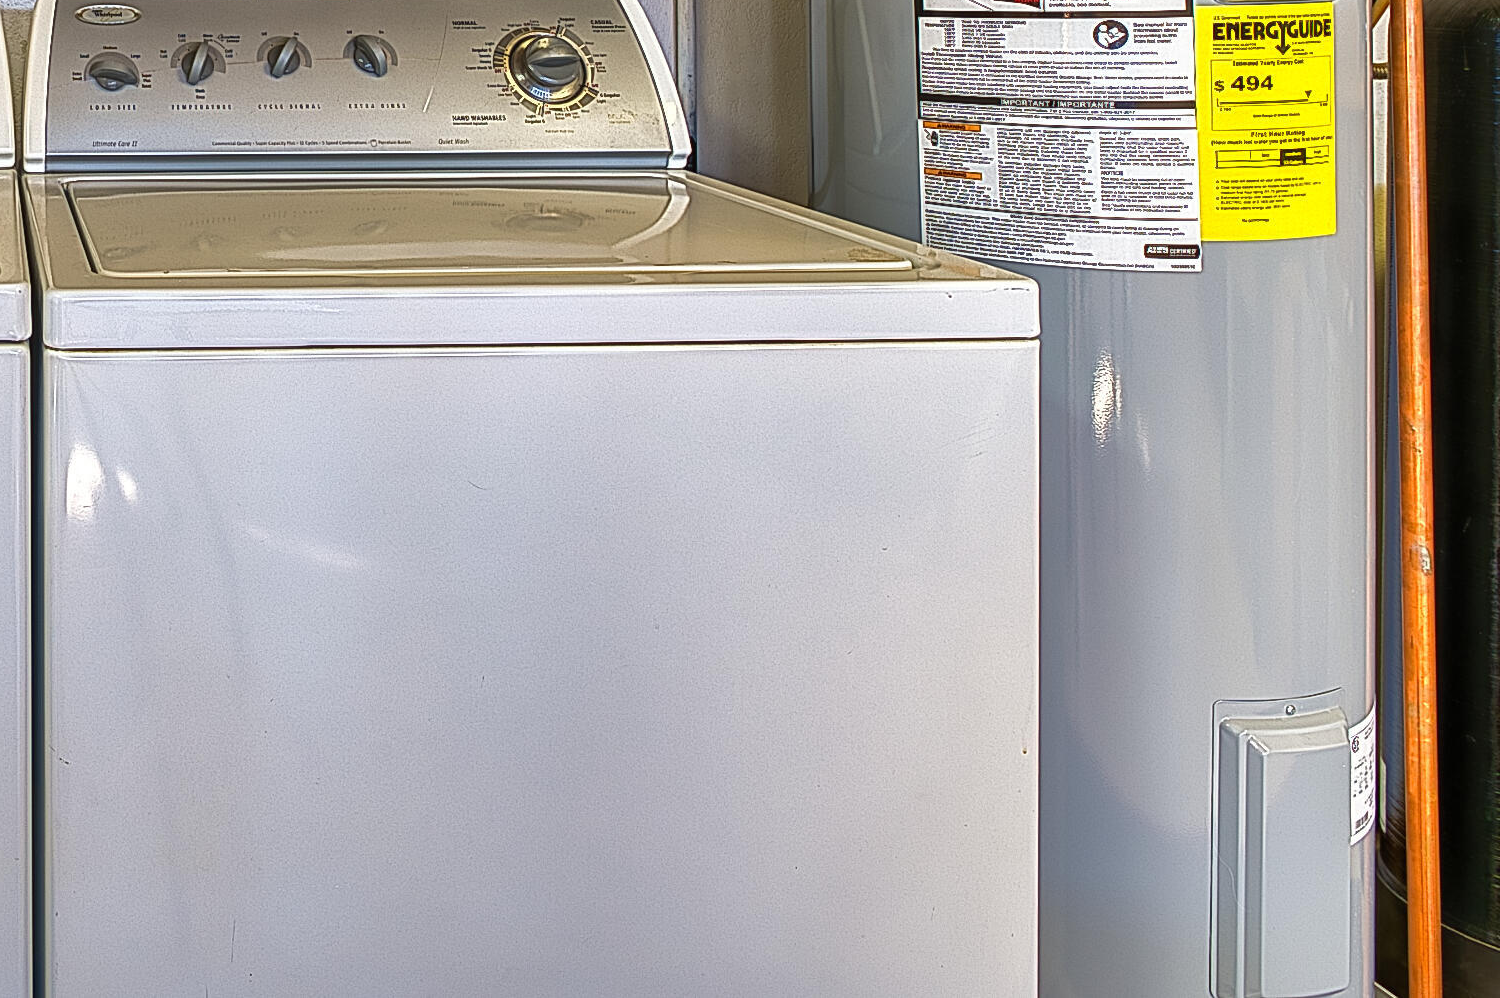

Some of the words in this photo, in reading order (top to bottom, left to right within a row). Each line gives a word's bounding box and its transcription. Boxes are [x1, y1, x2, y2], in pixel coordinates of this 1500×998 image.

[94, 10, 123, 18] Whirlpool
[1212, 19, 1332, 44] ENERGYGUIDE
[1214, 80, 1224, 92] $
[1231, 75, 1273, 91] 494
